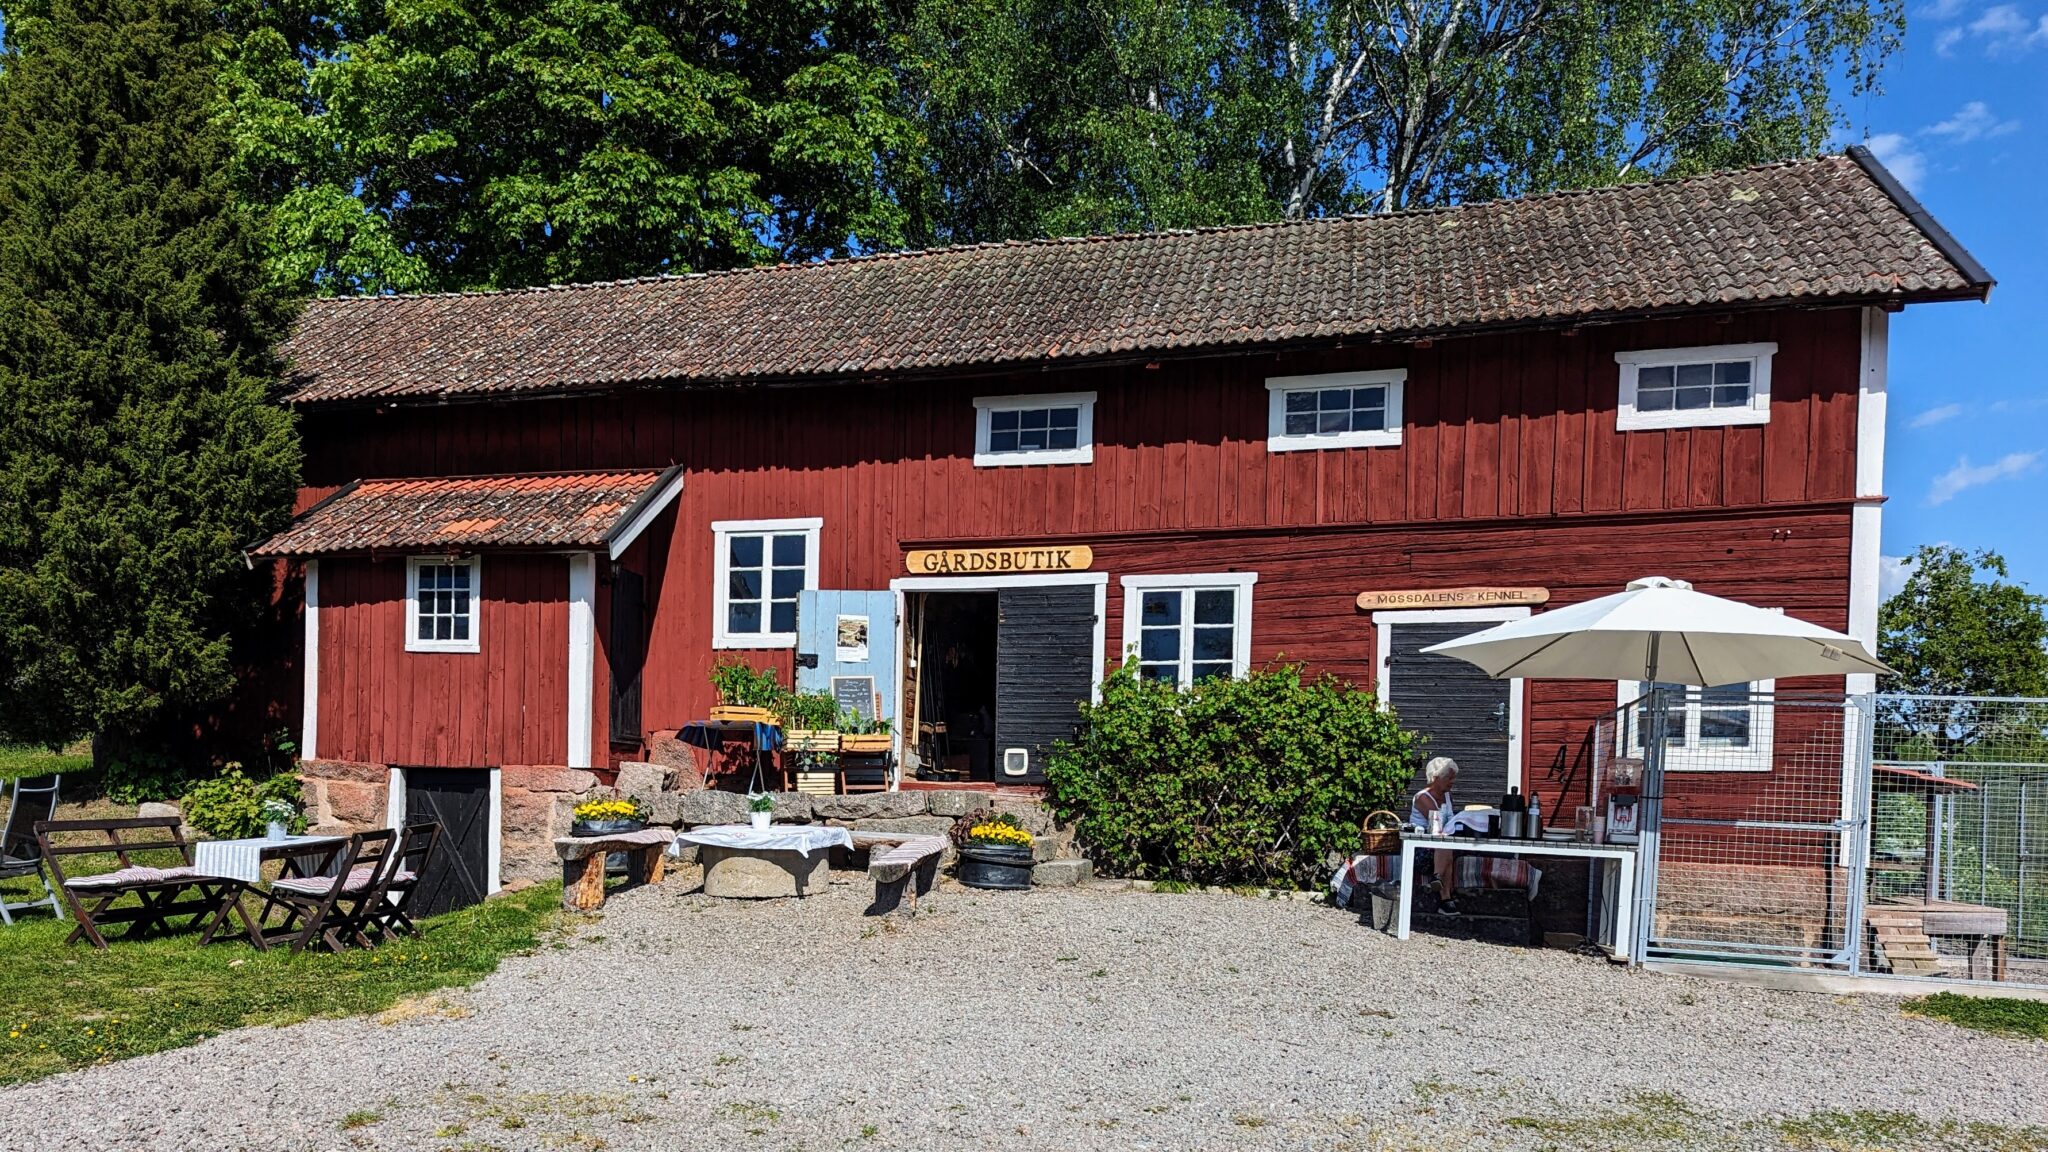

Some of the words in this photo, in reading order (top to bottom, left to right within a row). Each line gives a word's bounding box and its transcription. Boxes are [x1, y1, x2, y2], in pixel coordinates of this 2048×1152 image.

[923, 550, 1072, 573] GÅRDSBUTIK
[1377, 592, 1465, 604] MOSSDALENS
[1477, 590, 1528, 602] KENNEL
